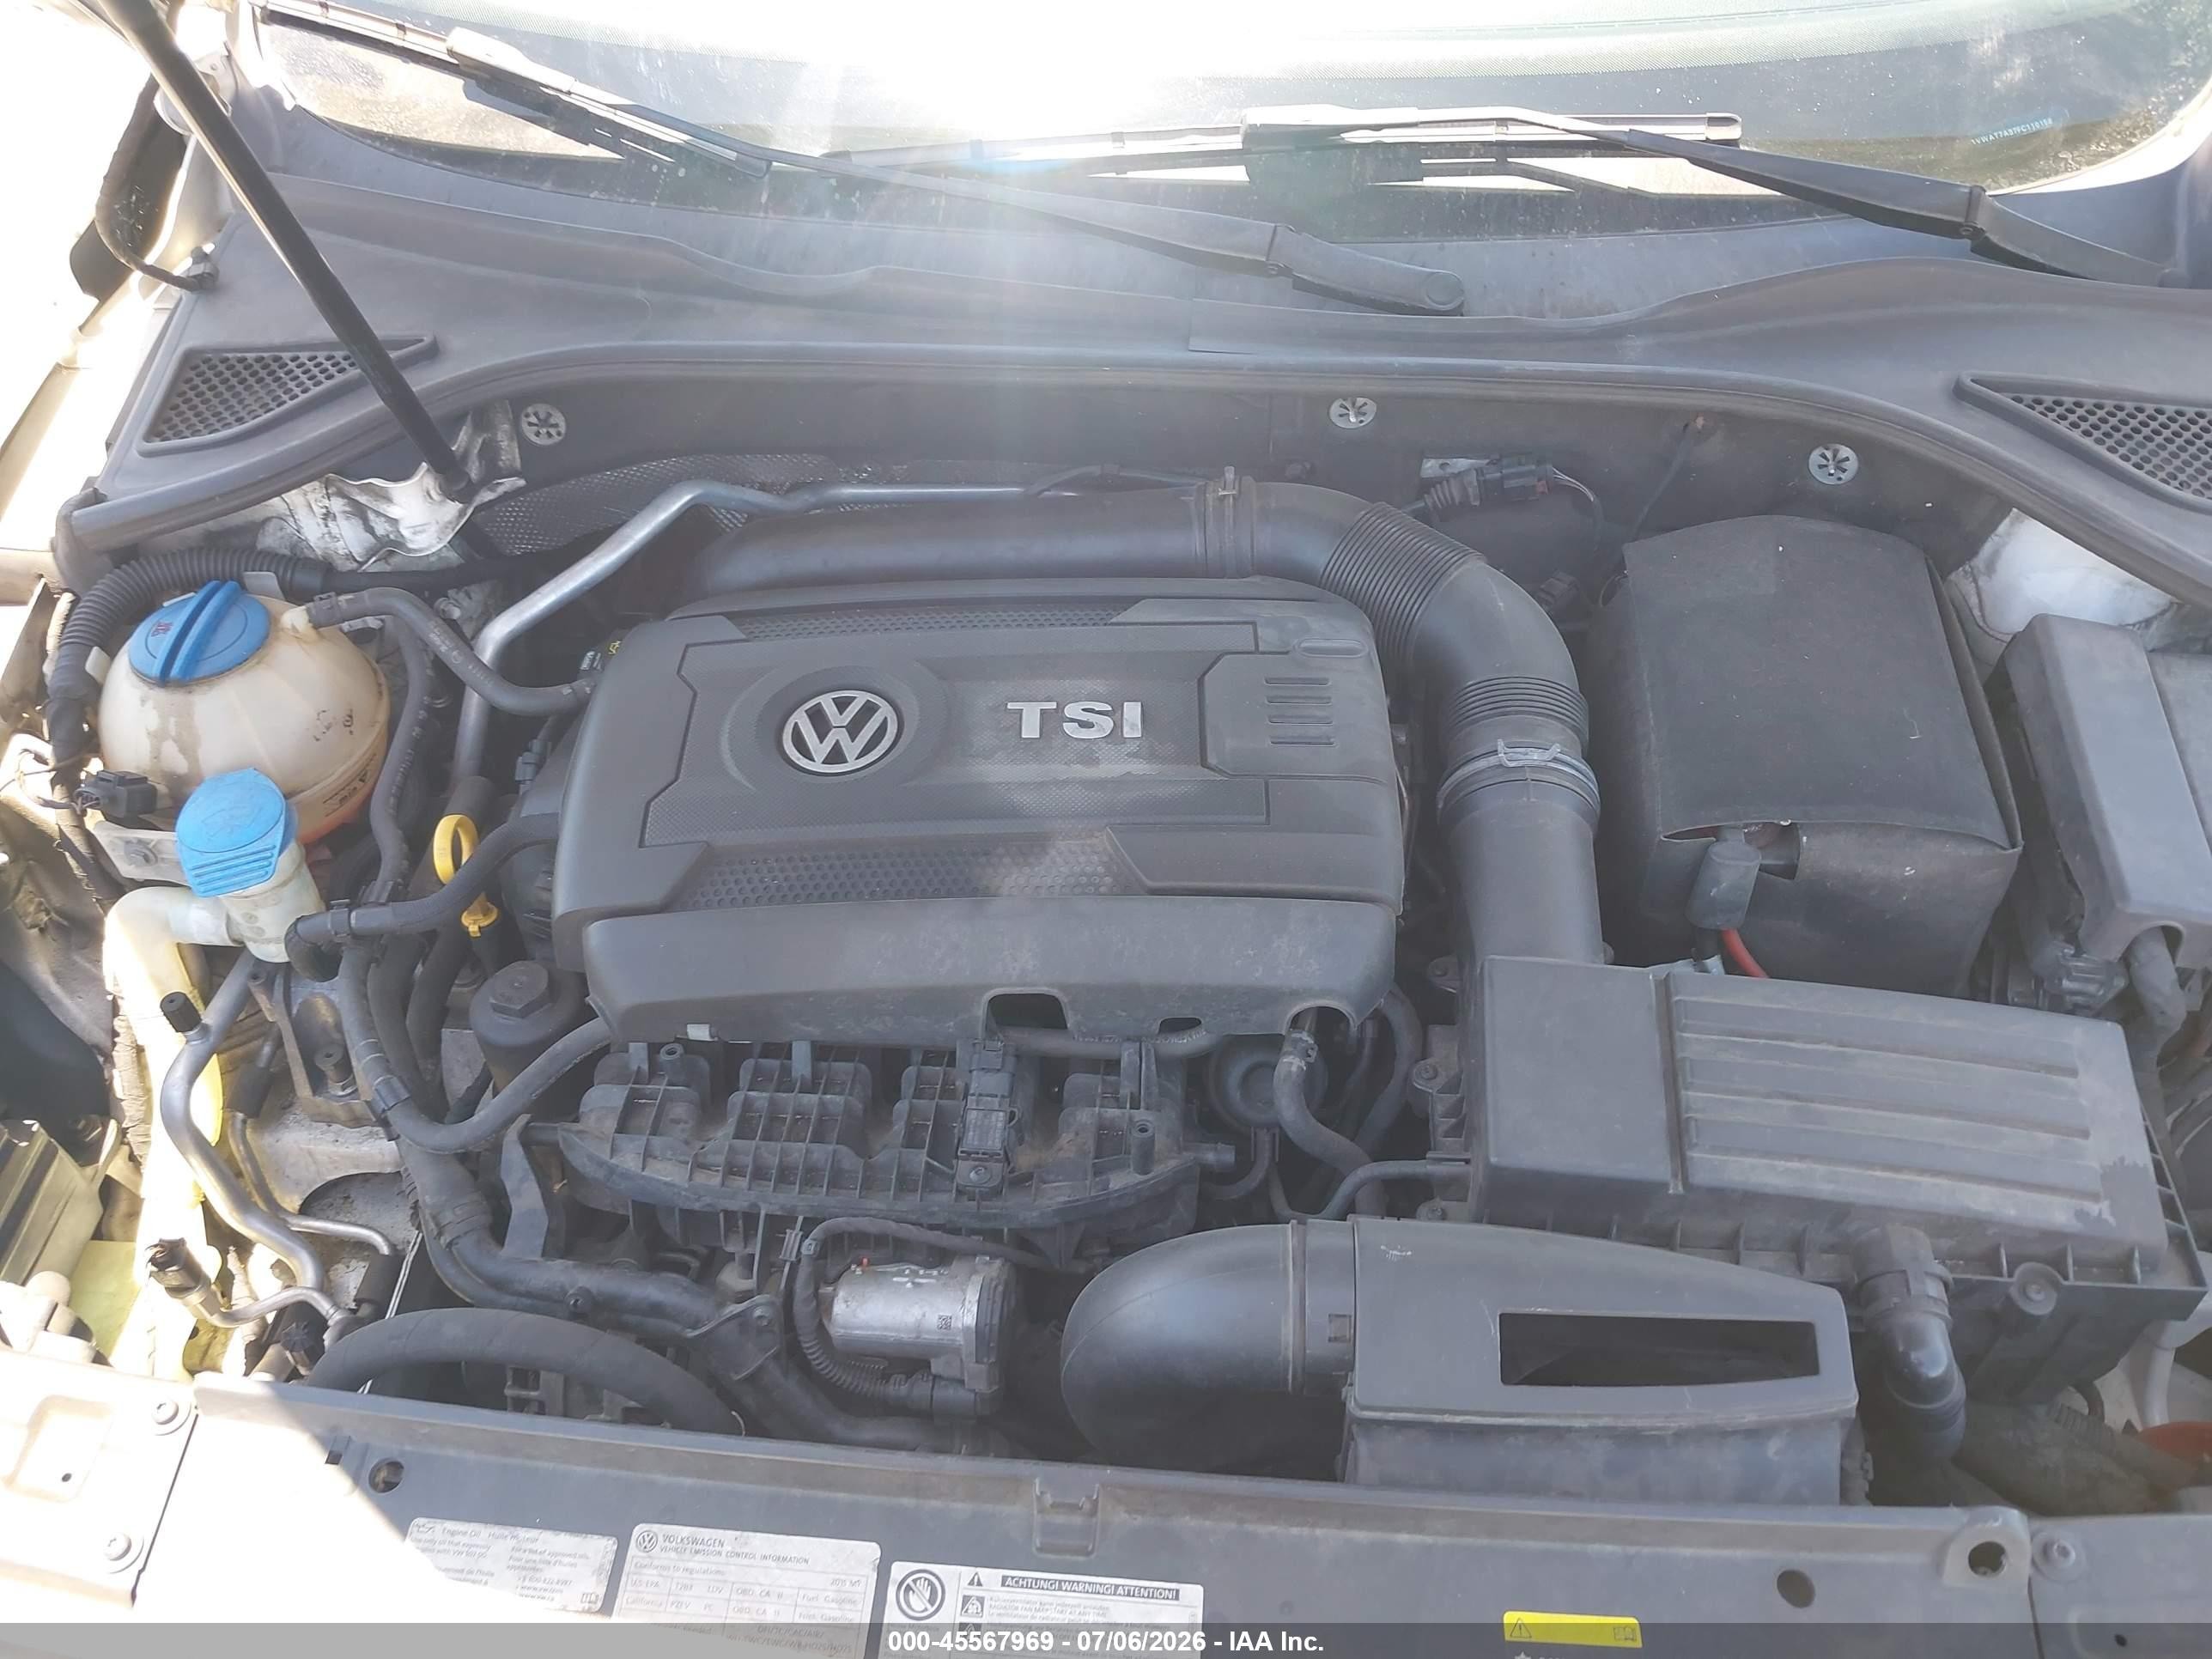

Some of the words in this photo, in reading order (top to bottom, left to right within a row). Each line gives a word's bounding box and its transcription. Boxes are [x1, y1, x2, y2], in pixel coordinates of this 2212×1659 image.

[1007, 701, 1145, 739] TSI
[441, 1527, 468, 1538] Engine
[662, 1533, 726, 1548] VOLKSWAGEN
[659, 1545, 687, 1554] VEHICLE
[689, 1547, 723, 1558] EMISSION
[726, 1551, 757, 1560] CONTROL
[760, 1553, 811, 1565] INFORMATION
[1005, 1576, 1060, 1591] ACHTUNG!
[1061, 1581, 1115, 1595] WARNING!
[1116, 1584, 1176, 1600] ATTENTION!
